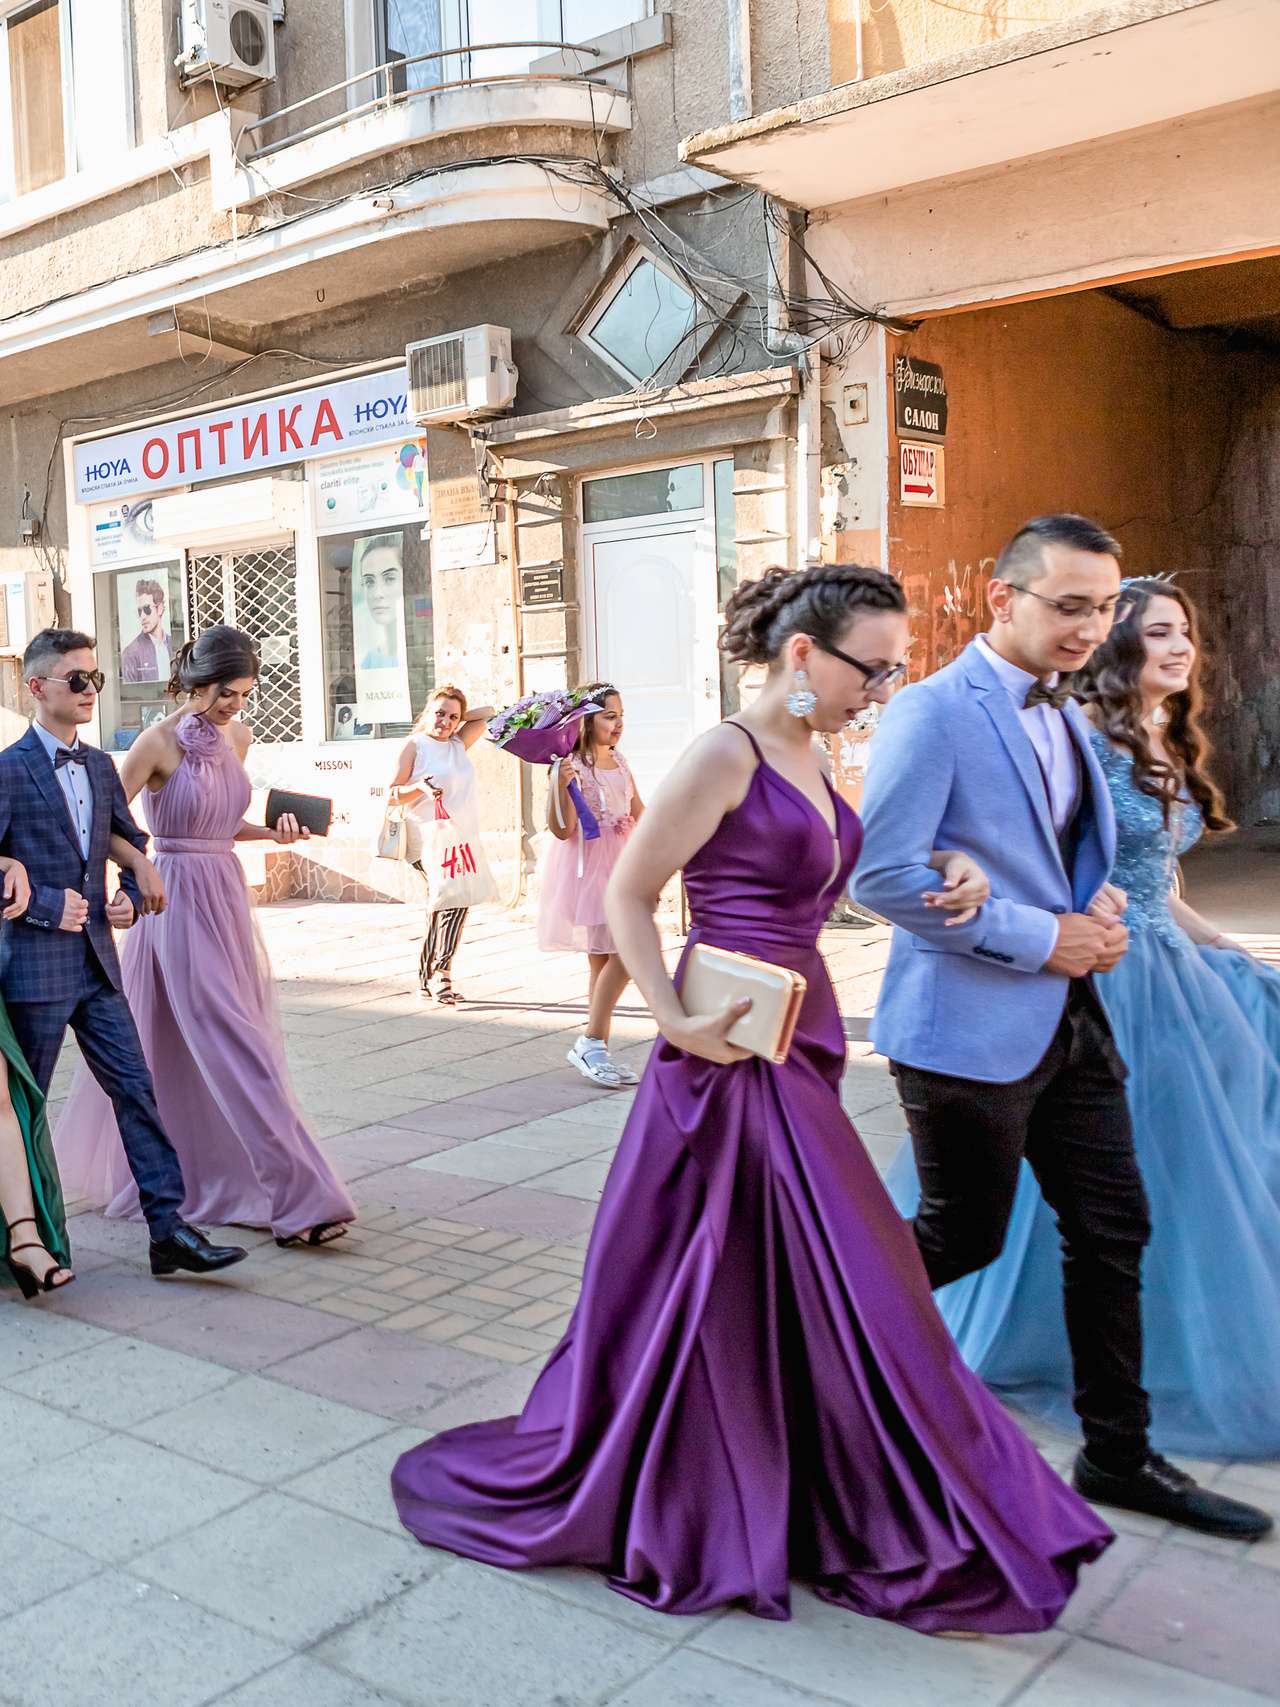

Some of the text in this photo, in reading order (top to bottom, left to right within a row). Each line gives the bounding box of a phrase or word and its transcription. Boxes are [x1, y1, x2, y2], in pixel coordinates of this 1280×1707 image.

[904, 406, 939, 431] САЛОН
[142, 398, 344, 480] ОПТИКА
[85, 458, 132, 482] HOYA
[320, 476, 360, 490] clariti elite
[314, 760, 353, 771] MISSONI
[441, 843, 477, 879] H&M
